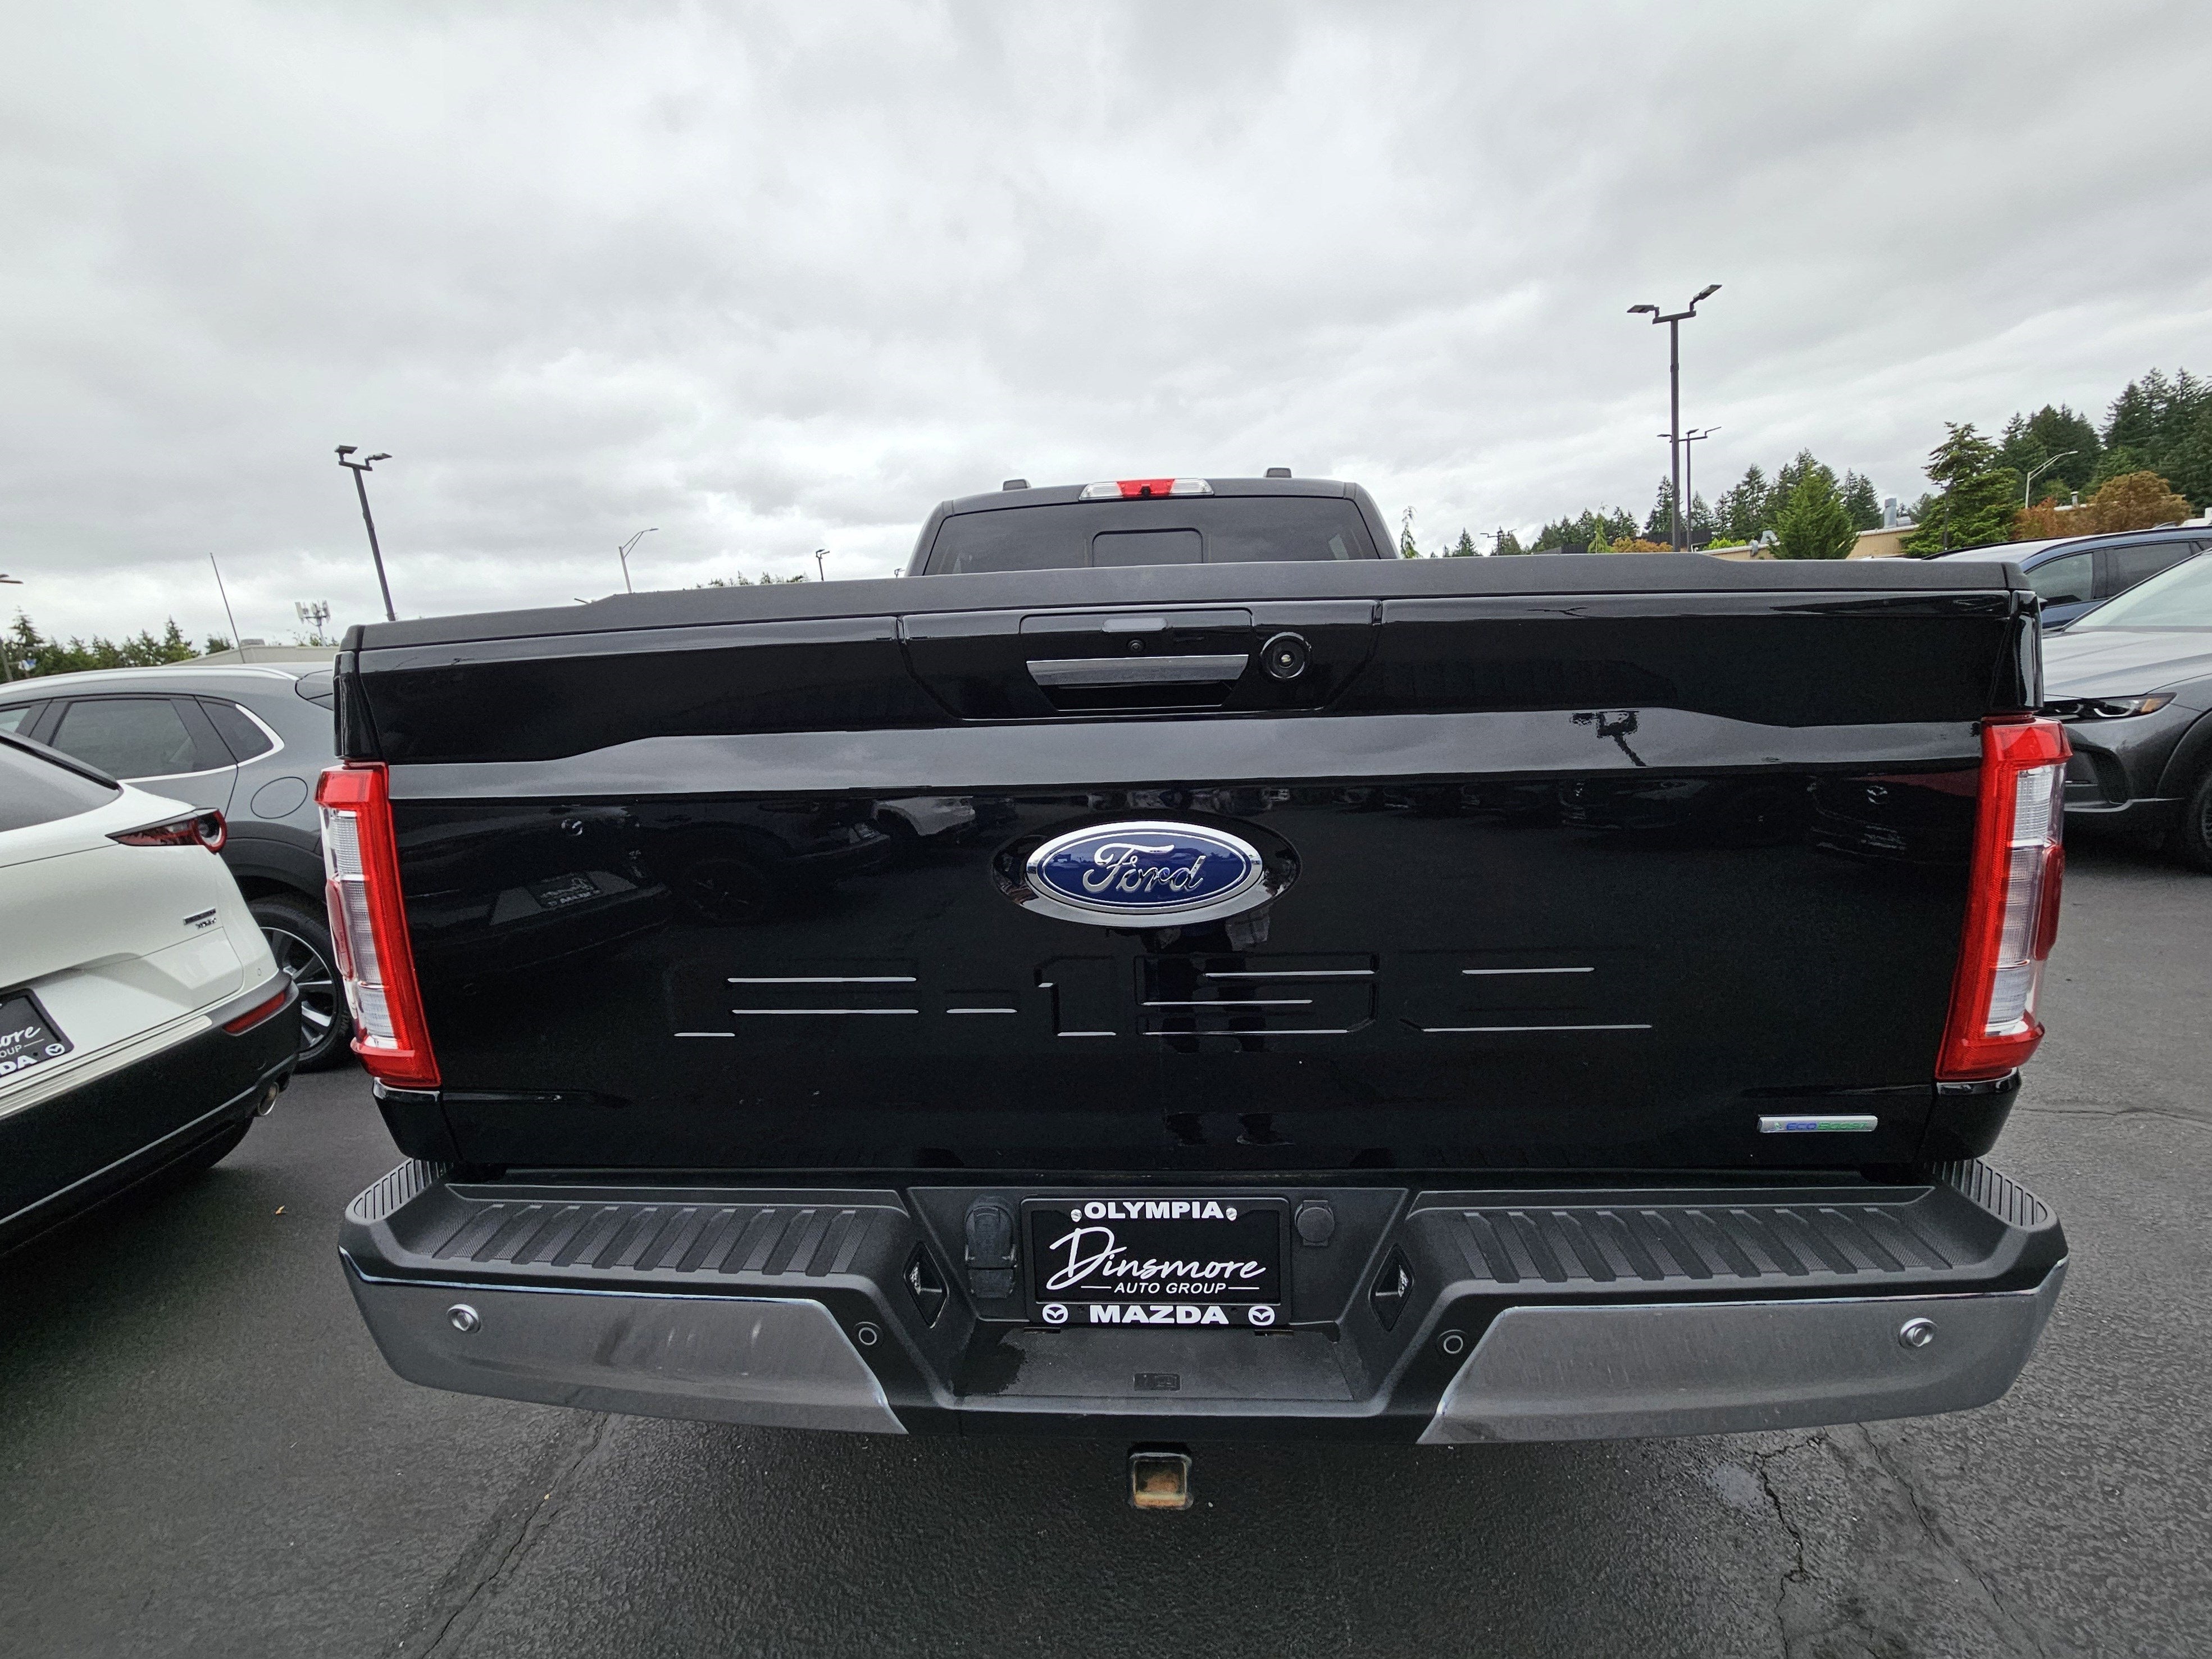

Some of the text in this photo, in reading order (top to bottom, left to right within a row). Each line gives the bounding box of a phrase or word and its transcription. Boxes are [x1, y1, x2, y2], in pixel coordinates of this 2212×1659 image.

[1082, 842, 1207, 893] Ford
[1084, 1201, 1225, 1219] OLYMPIA
[1046, 1226, 1266, 1290] Dinsmore
[1114, 1282, 1227, 1294] AUTO GROUP
[1089, 1305, 1229, 1324] MAZDA
